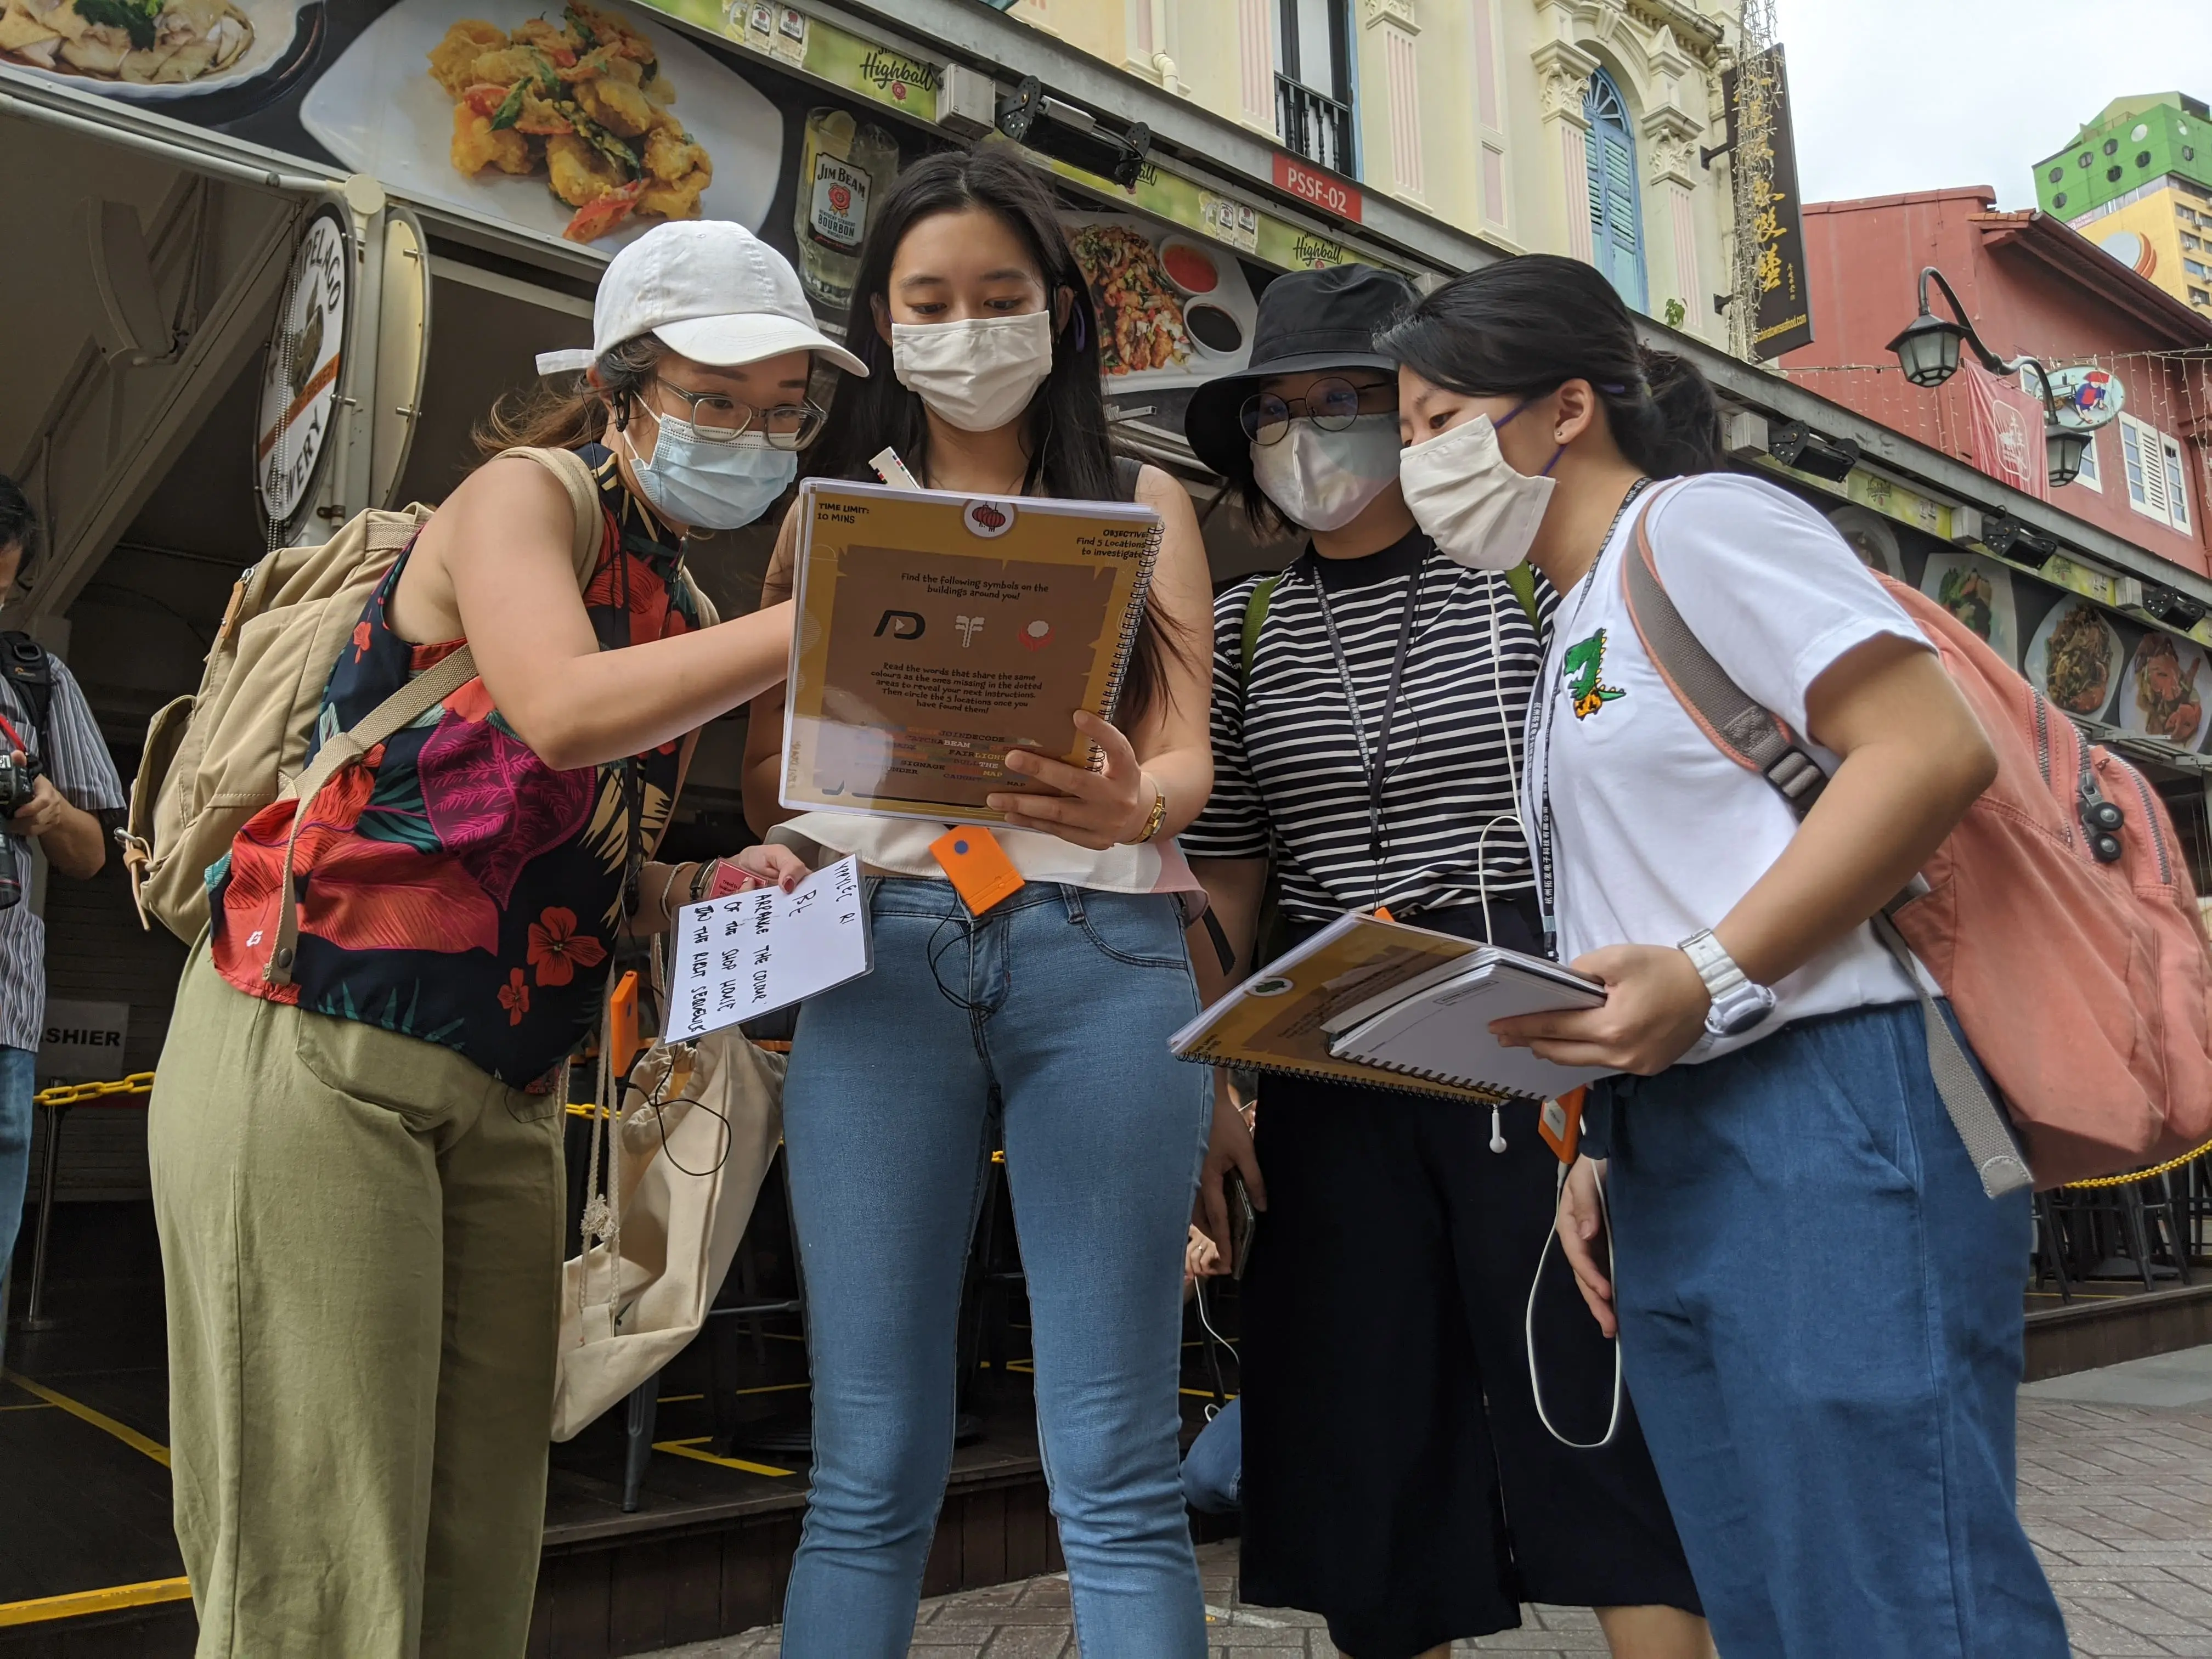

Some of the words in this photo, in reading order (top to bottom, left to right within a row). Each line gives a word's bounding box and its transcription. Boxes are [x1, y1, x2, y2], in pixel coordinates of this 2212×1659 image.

[860, 52, 933, 91] Highball
[817, 164, 836, 180] JIM
[838, 167, 866, 199] BEAM
[1288, 167, 1347, 213] PSSF-02
[818, 214, 855, 238] BOURBON
[1293, 236, 1343, 267] Highball
[831, 514, 855, 524] MINS
[843, 505, 870, 514] LIMIT:
[1077, 537, 1095, 545] Find
[1104, 540, 1146, 548] Locations
[1103, 529, 1149, 538] OBJECTIVE:
[1094, 549, 1143, 560] investigate
[901, 573, 920, 582] Find
[923, 574, 938, 583] the
[940, 576, 981, 589] following
[983, 580, 1019, 591] symbols
[1034, 583, 1049, 592] the
[927, 584, 967, 597] buildings
[969, 589, 1000, 599] around
[1002, 592, 1020, 602] you!
[1321, 599, 1336, 635] 400-816-7211
[871, 670, 901, 679] colours
[916, 674, 929, 682] the
[953, 679, 986, 690] missing
[998, 681, 1012, 689] the
[1014, 681, 1042, 690] dotted
[883, 662, 904, 671] Read
[906, 664, 921, 673] the
[923, 667, 949, 675] words
[951, 669, 969, 678] that
[972, 670, 996, 679] share
[998, 673, 1012, 681] the
[876, 679, 899, 687] areas
[913, 682, 940, 692] reveal
[942, 686, 961, 695] your
[985, 689, 1036, 698] instructions.
[882, 688, 902, 696] Then
[905, 690, 928, 699] circle
[930, 693, 944, 701] the
[954, 696, 991, 706] locations
[917, 699, 936, 708] have
[939, 702, 962, 711] found
[964, 704, 989, 713] them!
[1543, 806, 1553, 905] 杭州拓发电子科技有限公司
[724, 901, 742, 912] OF
[693, 926, 709, 944] THE
[725, 921, 738, 936] THE
[721, 949, 739, 970] SHOP
[753, 945, 772, 965] THE
[717, 979, 737, 1012] HOUSE
[752, 970, 767, 1003] COLOUR
[41, 1028, 121, 1047] SHIER
